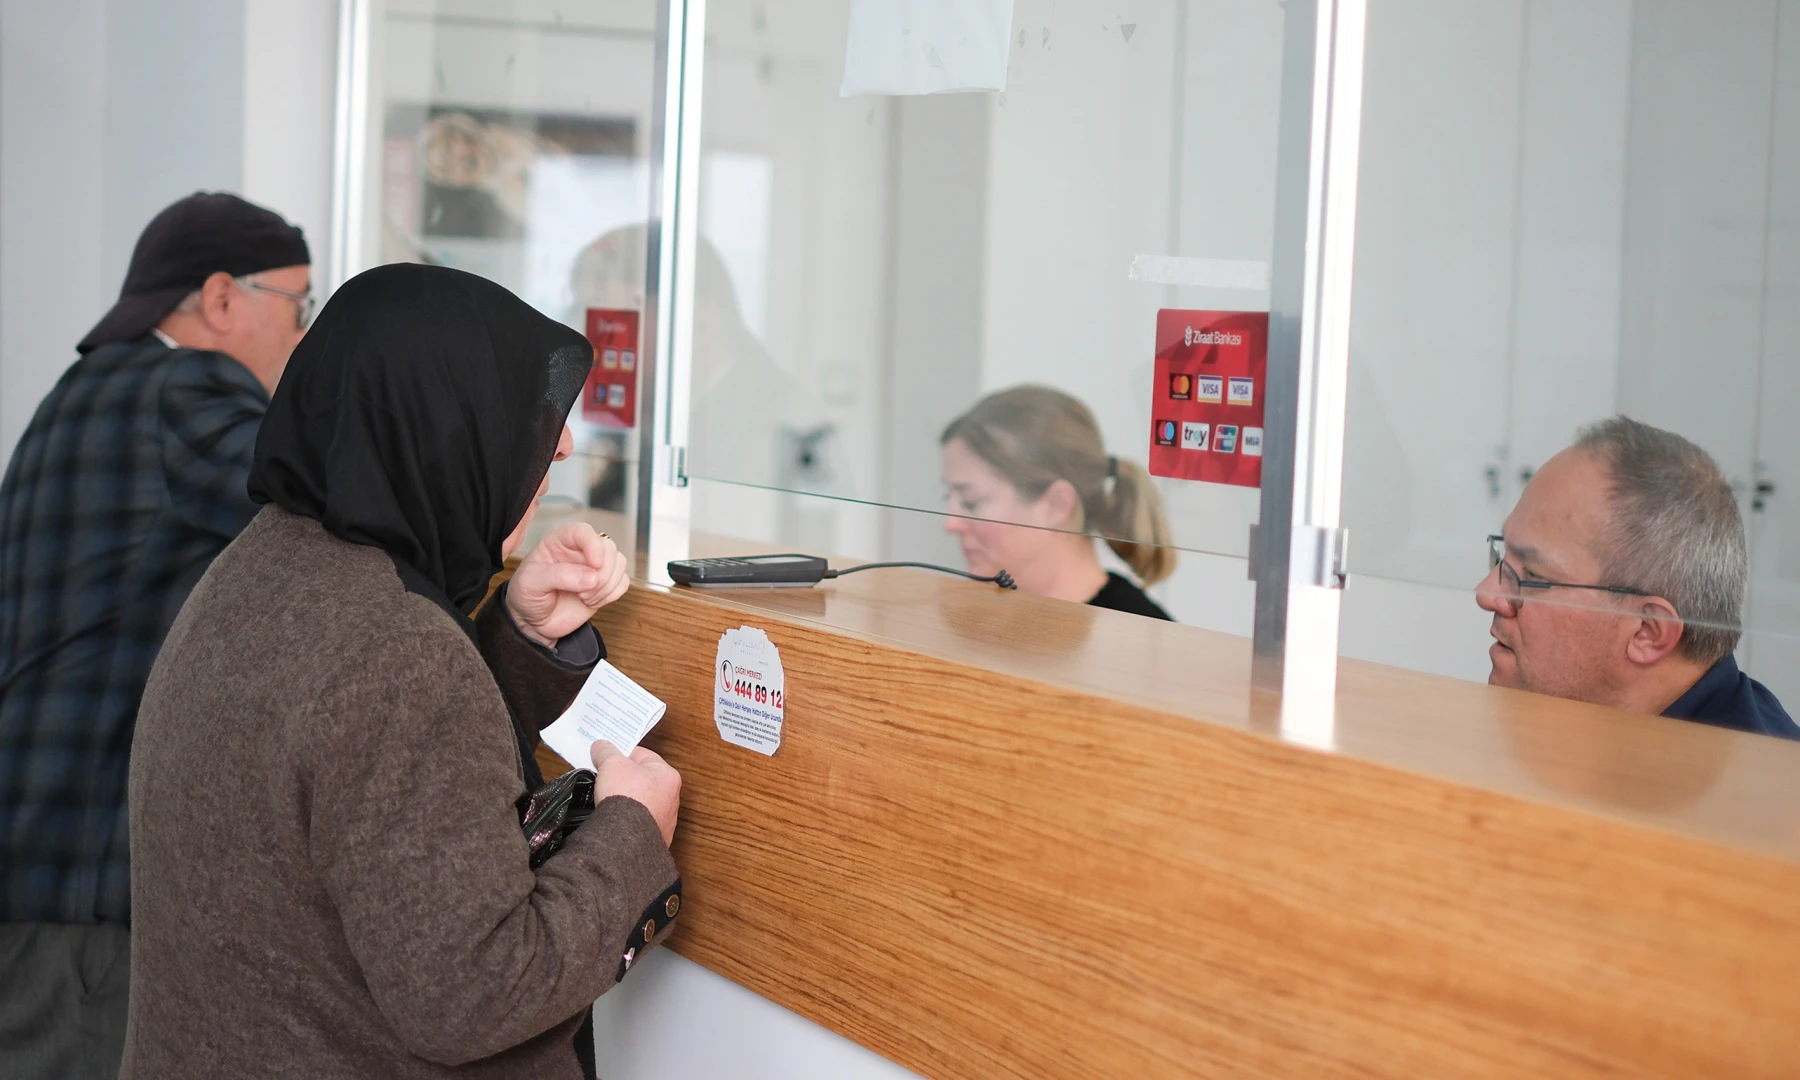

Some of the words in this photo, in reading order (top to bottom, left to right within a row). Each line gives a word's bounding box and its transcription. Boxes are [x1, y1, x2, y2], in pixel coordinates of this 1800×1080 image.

[1193, 330, 1213, 344] Ziraat
[1202, 383, 1219, 395] VISA
[1232, 384, 1249, 396] VISA
[1184, 426, 1207, 447] troy
[734, 679, 752, 699] 444
[755, 684, 767, 704] 89
[771, 689, 782, 709] 12
